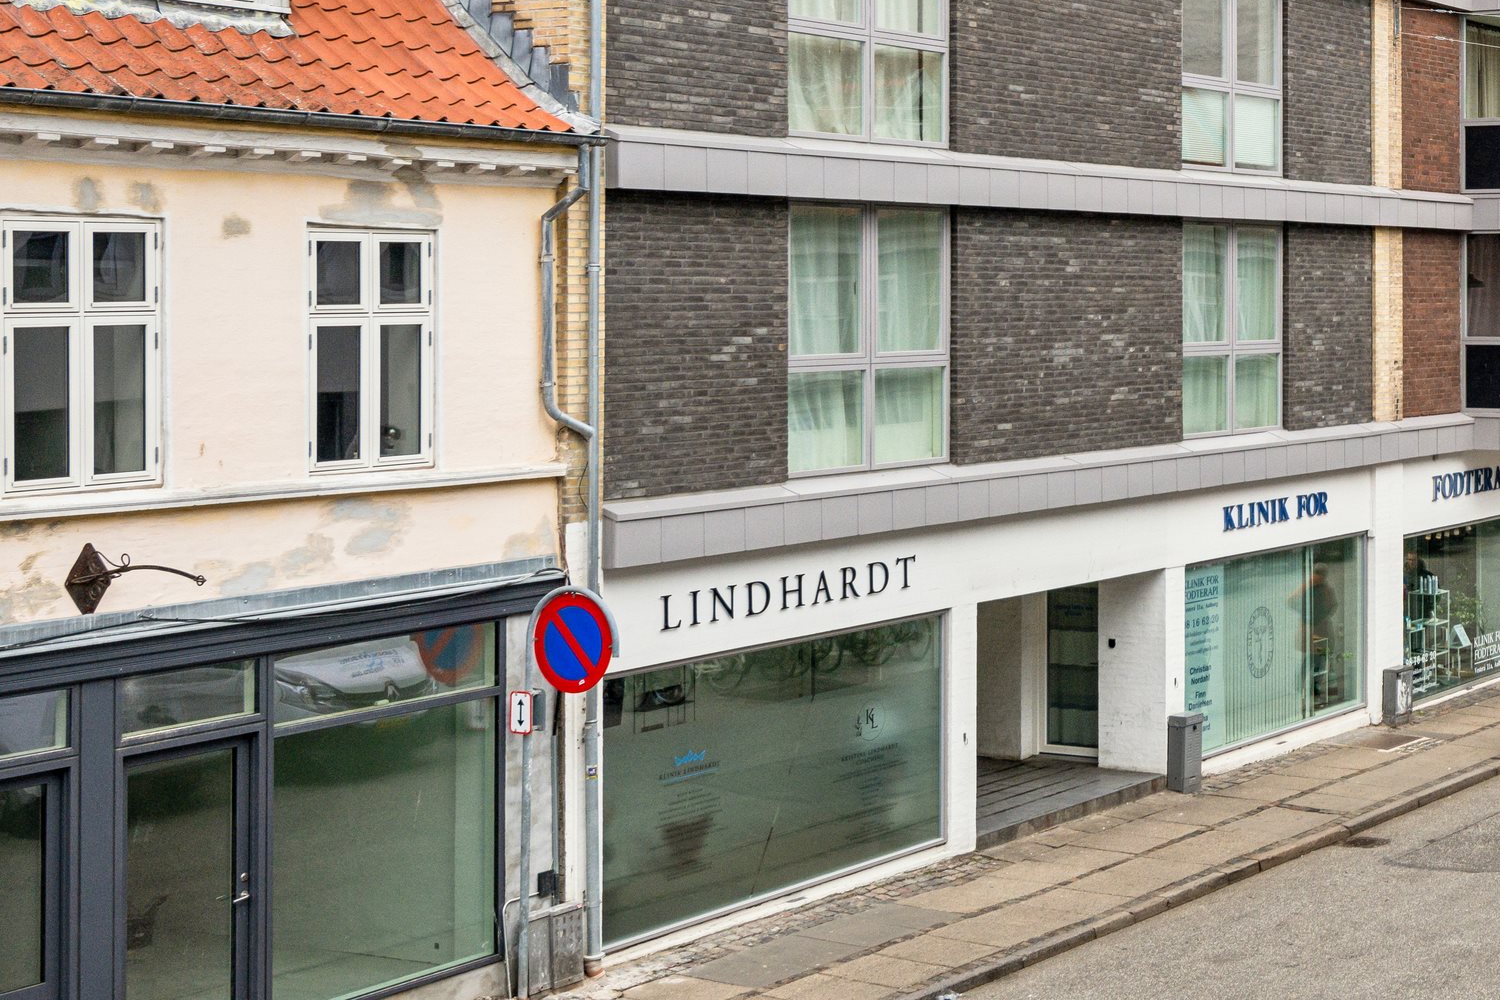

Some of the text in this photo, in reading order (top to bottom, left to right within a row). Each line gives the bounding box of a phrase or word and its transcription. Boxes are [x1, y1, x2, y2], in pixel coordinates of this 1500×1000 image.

[1223, 491, 1329, 532] KLINIK FOR
[660, 554, 917, 632] LINDHARDT
[1206, 574, 1219, 586] FOR
[1474, 632, 1494, 648] KLINIK
